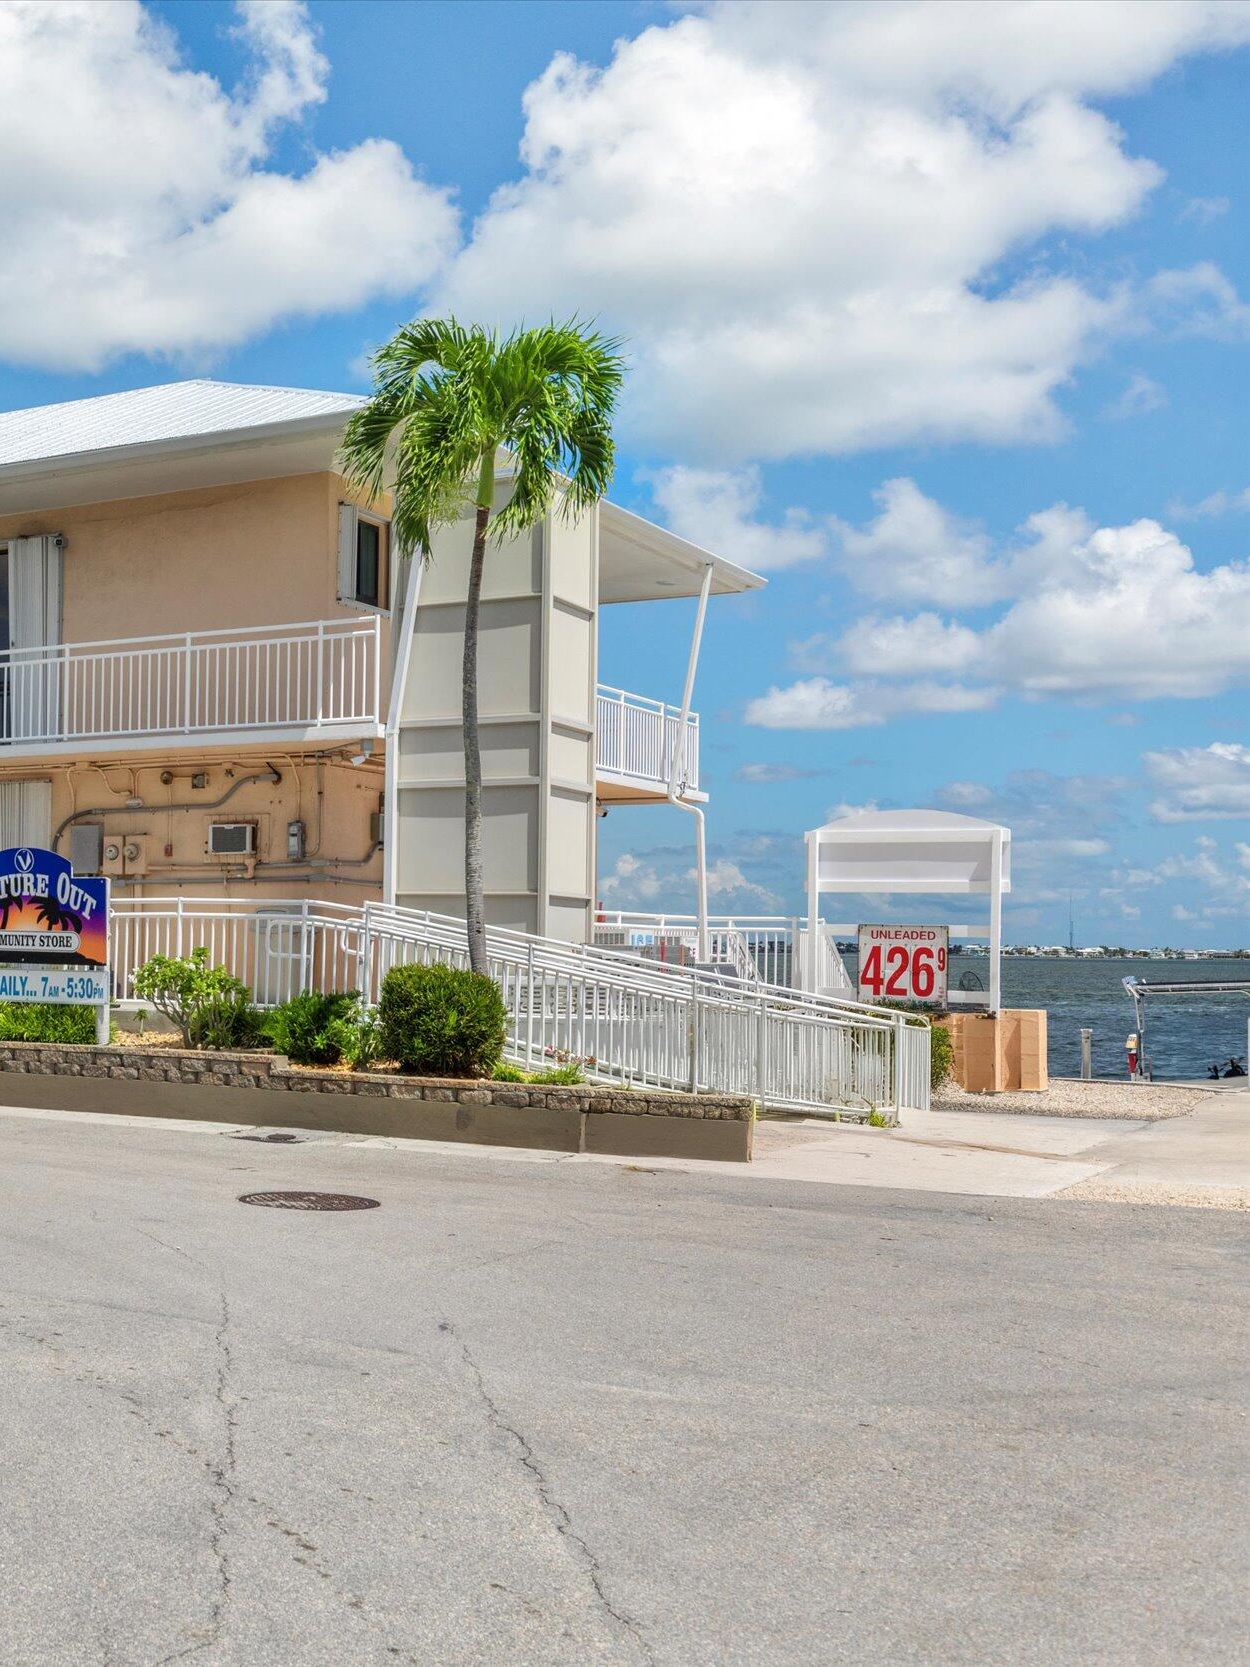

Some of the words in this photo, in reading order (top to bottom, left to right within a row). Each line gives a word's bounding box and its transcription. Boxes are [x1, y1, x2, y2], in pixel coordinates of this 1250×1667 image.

[57, 872, 97, 919] OUT
[39, 935, 72, 948] STORE
[871, 930, 936, 940] UNLEADED
